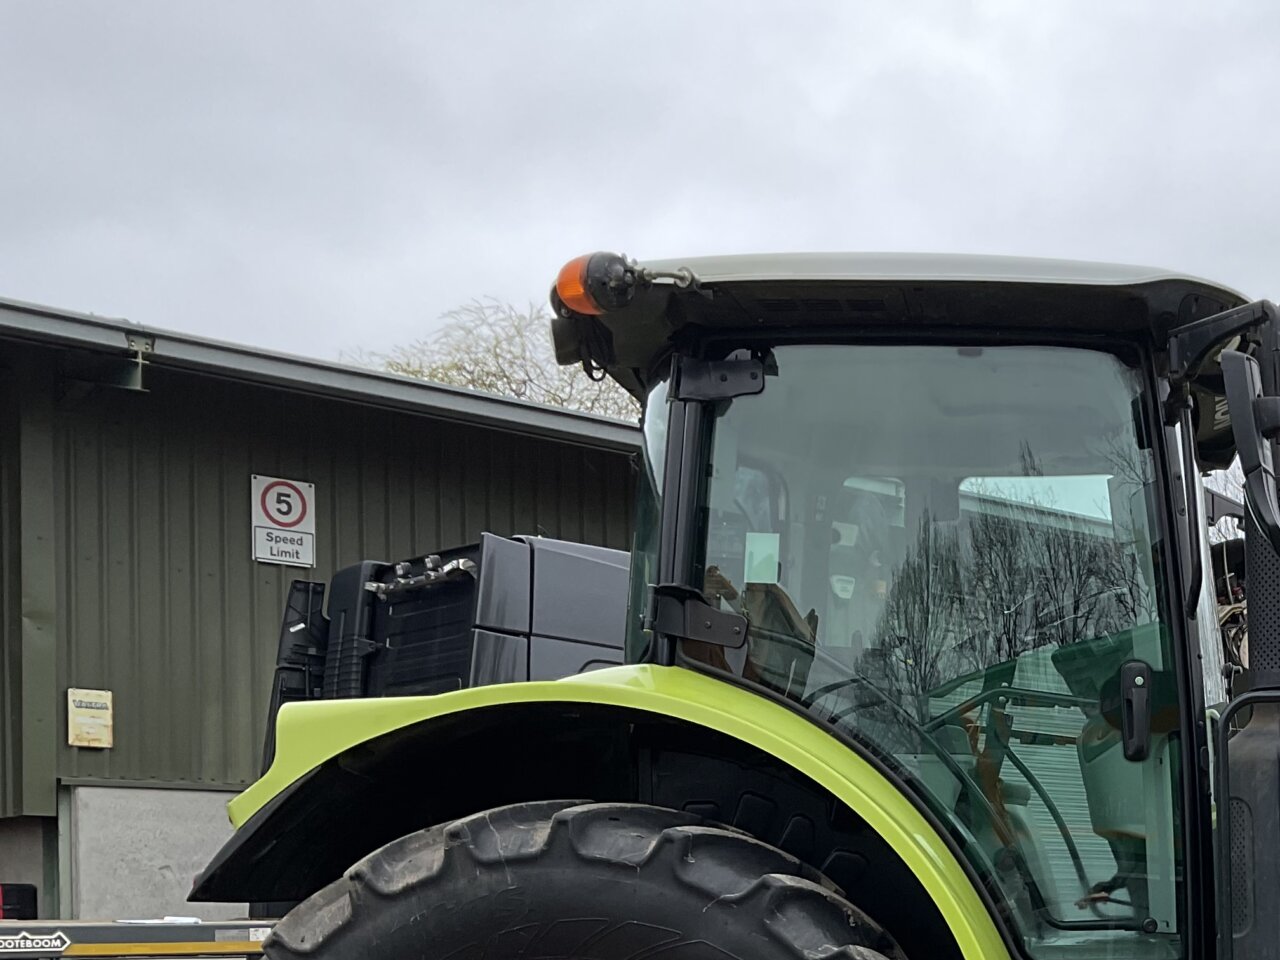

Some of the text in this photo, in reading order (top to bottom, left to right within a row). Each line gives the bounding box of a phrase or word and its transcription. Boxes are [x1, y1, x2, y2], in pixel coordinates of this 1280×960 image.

[275, 491, 293, 516] 5
[266, 531, 304, 546] Speed
[269, 546, 301, 560] Limit
